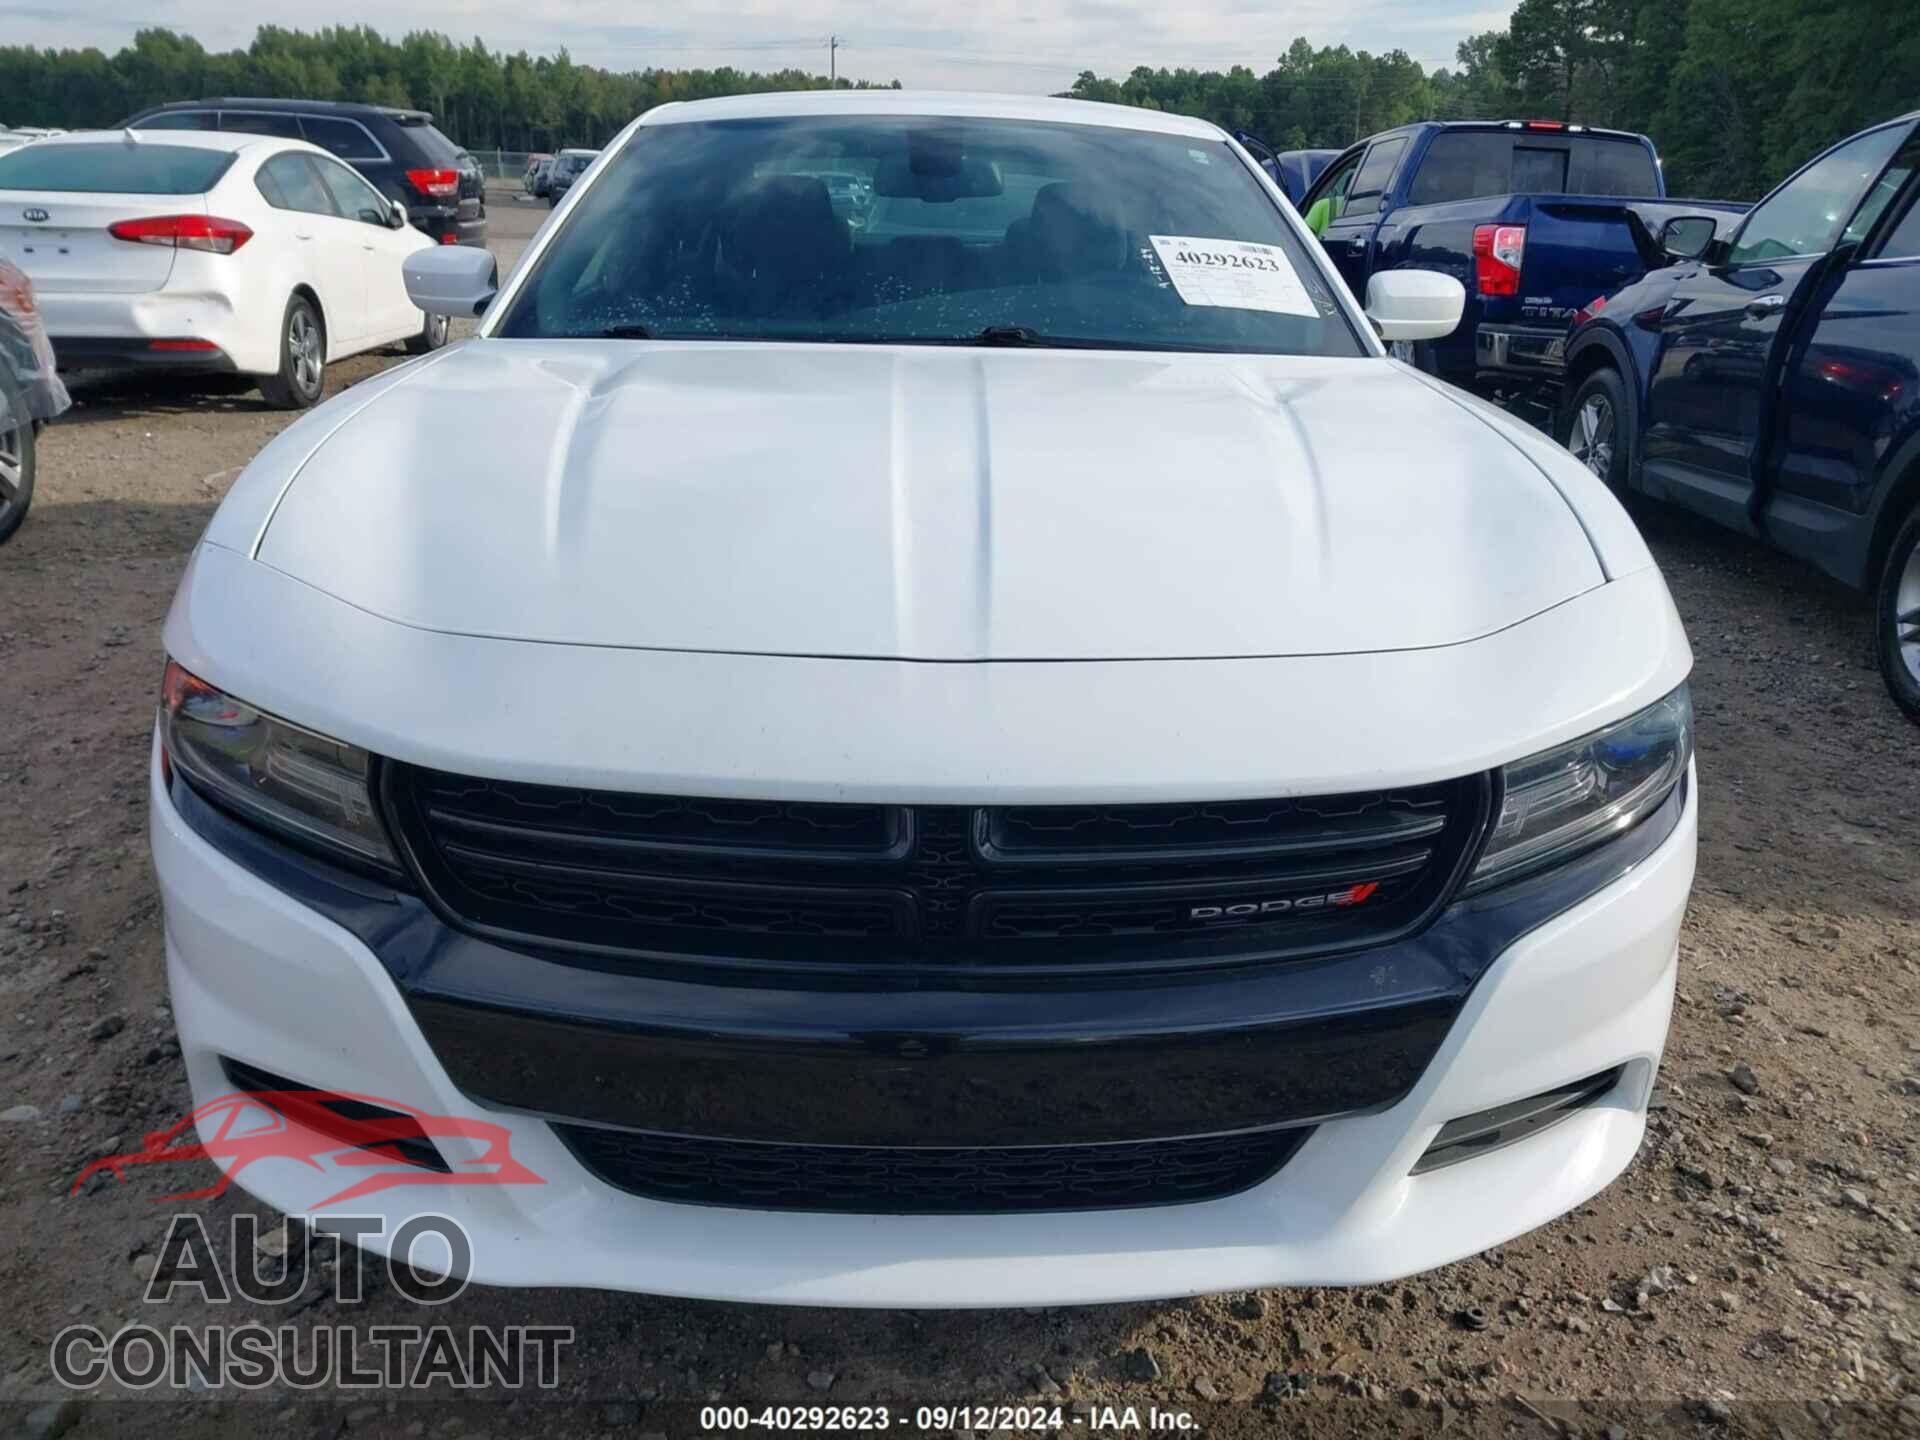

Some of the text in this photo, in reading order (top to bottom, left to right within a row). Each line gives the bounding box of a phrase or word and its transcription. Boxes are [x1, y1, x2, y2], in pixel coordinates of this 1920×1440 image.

[24, 209, 48, 220] KIA
[1175, 250, 1281, 273] 40292623
[1191, 890, 1356, 918] DODGE
